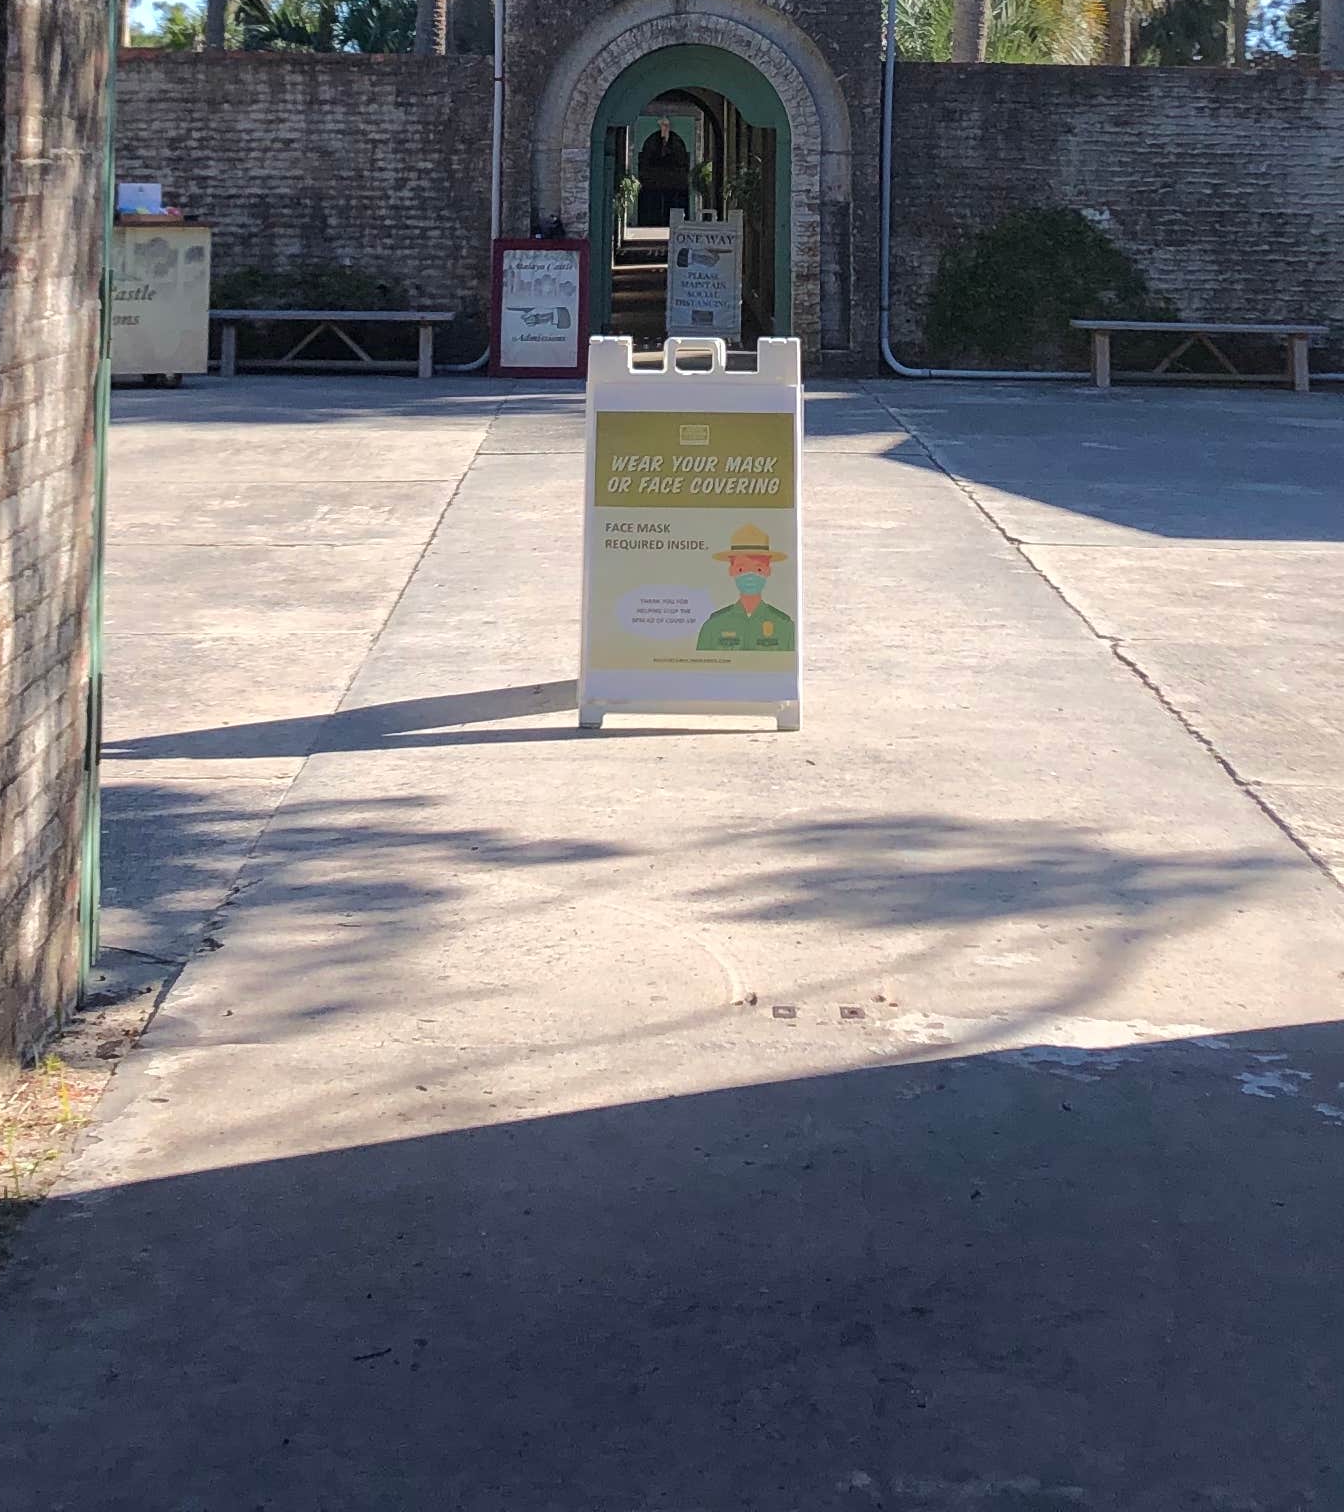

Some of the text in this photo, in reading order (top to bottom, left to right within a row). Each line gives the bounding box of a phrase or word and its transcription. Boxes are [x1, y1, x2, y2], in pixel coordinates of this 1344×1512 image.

[676, 233, 735, 246] ONE WAY
[611, 455, 778, 473] WEAR YOUR MASK
[607, 476, 781, 495] OR FACE COVERING
[605, 522, 671, 534] FACE MASK
[605, 538, 709, 551] REQUIRED INSIDE.
